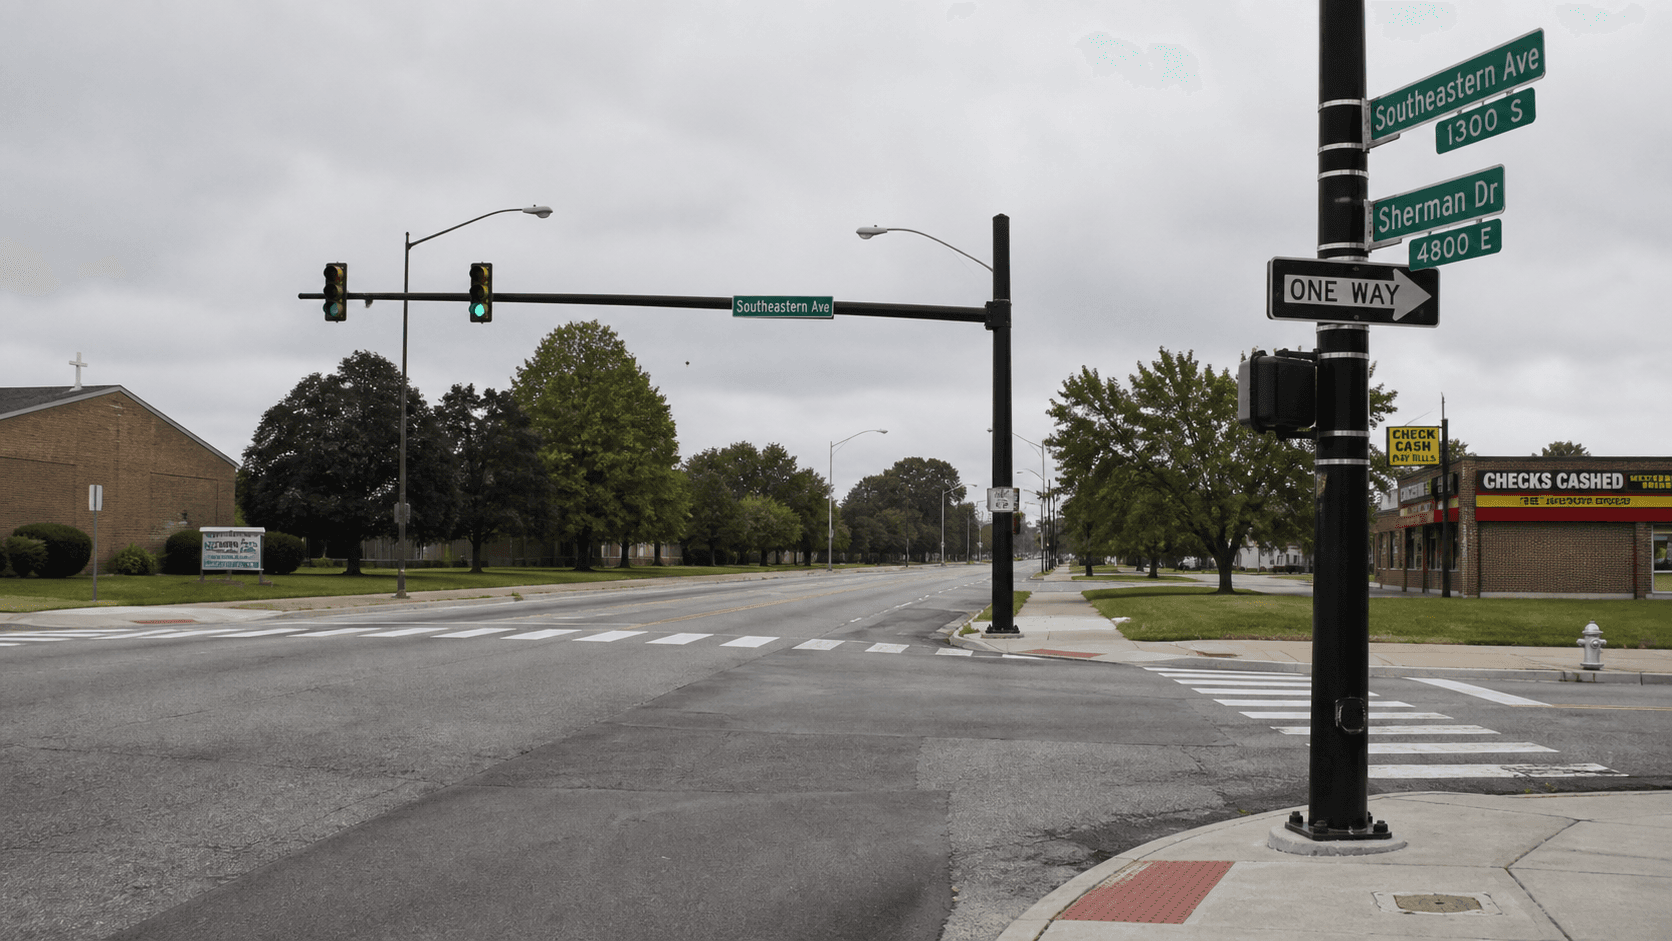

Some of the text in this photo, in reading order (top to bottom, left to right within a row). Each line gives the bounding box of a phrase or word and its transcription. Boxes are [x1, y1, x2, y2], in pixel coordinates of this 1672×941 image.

[1375, 47, 1540, 131] Southeastern Ave
[1447, 98, 1523, 146] 1300 S
[1378, 180, 1498, 233] Sherman Dr
[1416, 226, 1492, 263] 4800 E
[1290, 278, 1401, 305] ONE WAY
[736, 299, 830, 313] Southeastern Ave
[1392, 429, 1436, 440] CHECK
[1395, 441, 1431, 452] CASH
[1483, 472, 1552, 489] CHECKS
[1556, 472, 1624, 489] CASHED
